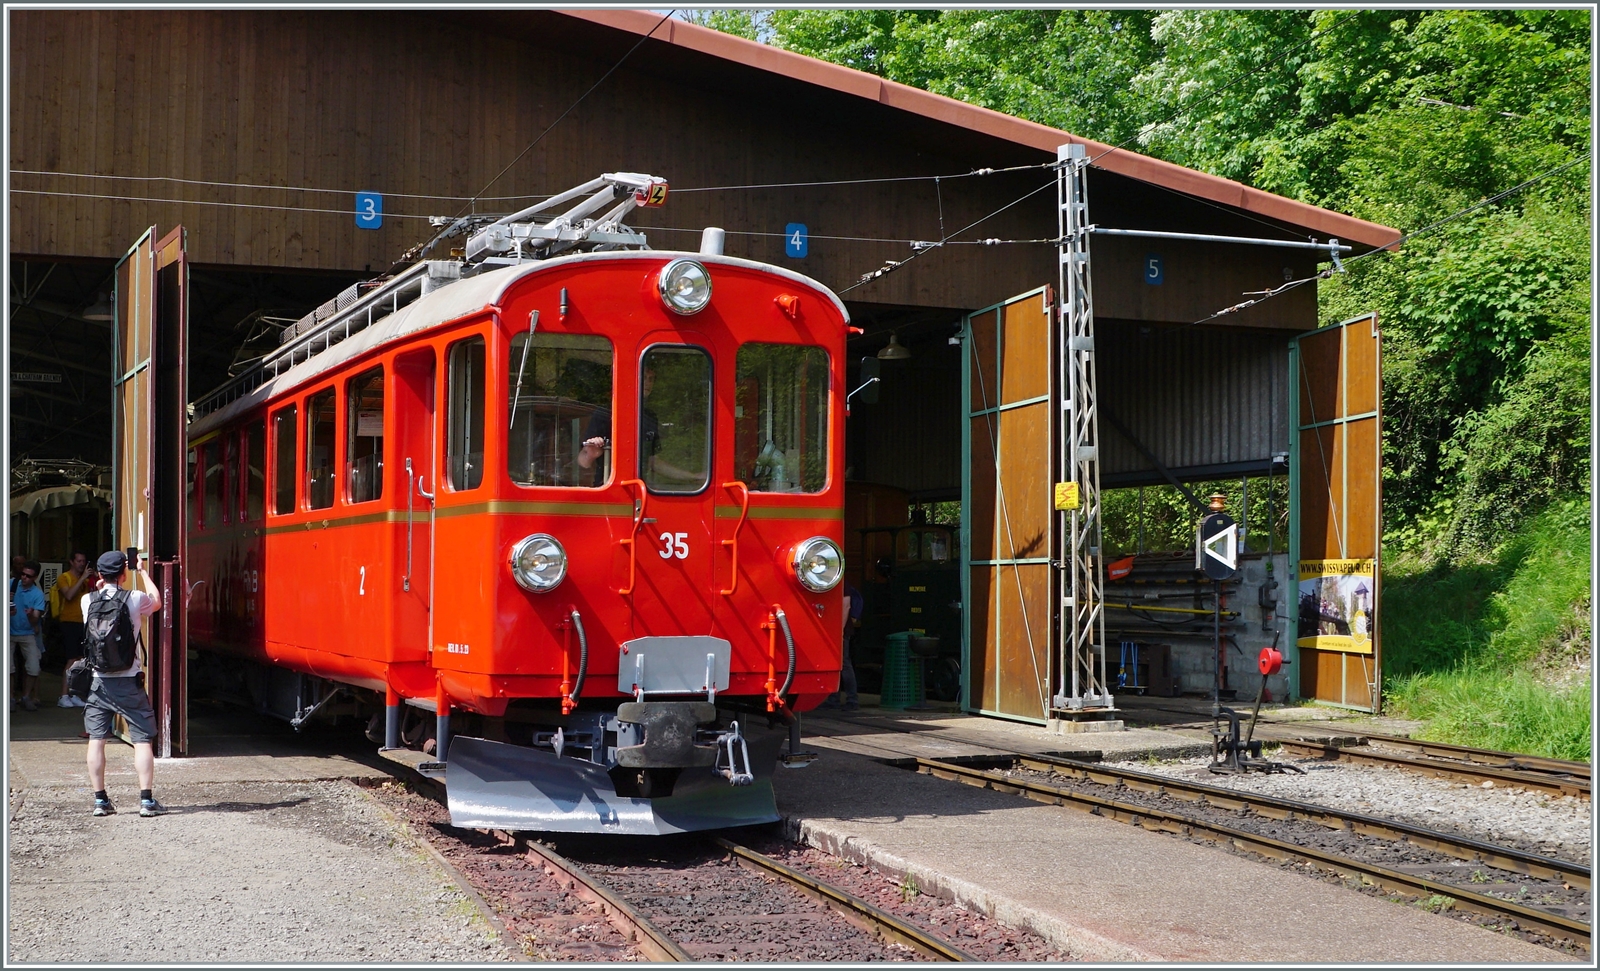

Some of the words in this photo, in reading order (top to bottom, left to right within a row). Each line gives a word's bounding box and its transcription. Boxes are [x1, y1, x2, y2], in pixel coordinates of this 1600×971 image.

[362, 198, 375, 221] 3
[790, 230, 802, 250] 4
[1149, 259, 1158, 278] 5
[659, 532, 689, 559] 35
[1300, 563, 1371, 574] WWW.SWISSVAPEUR.CH
[359, 565, 365, 596] 2
